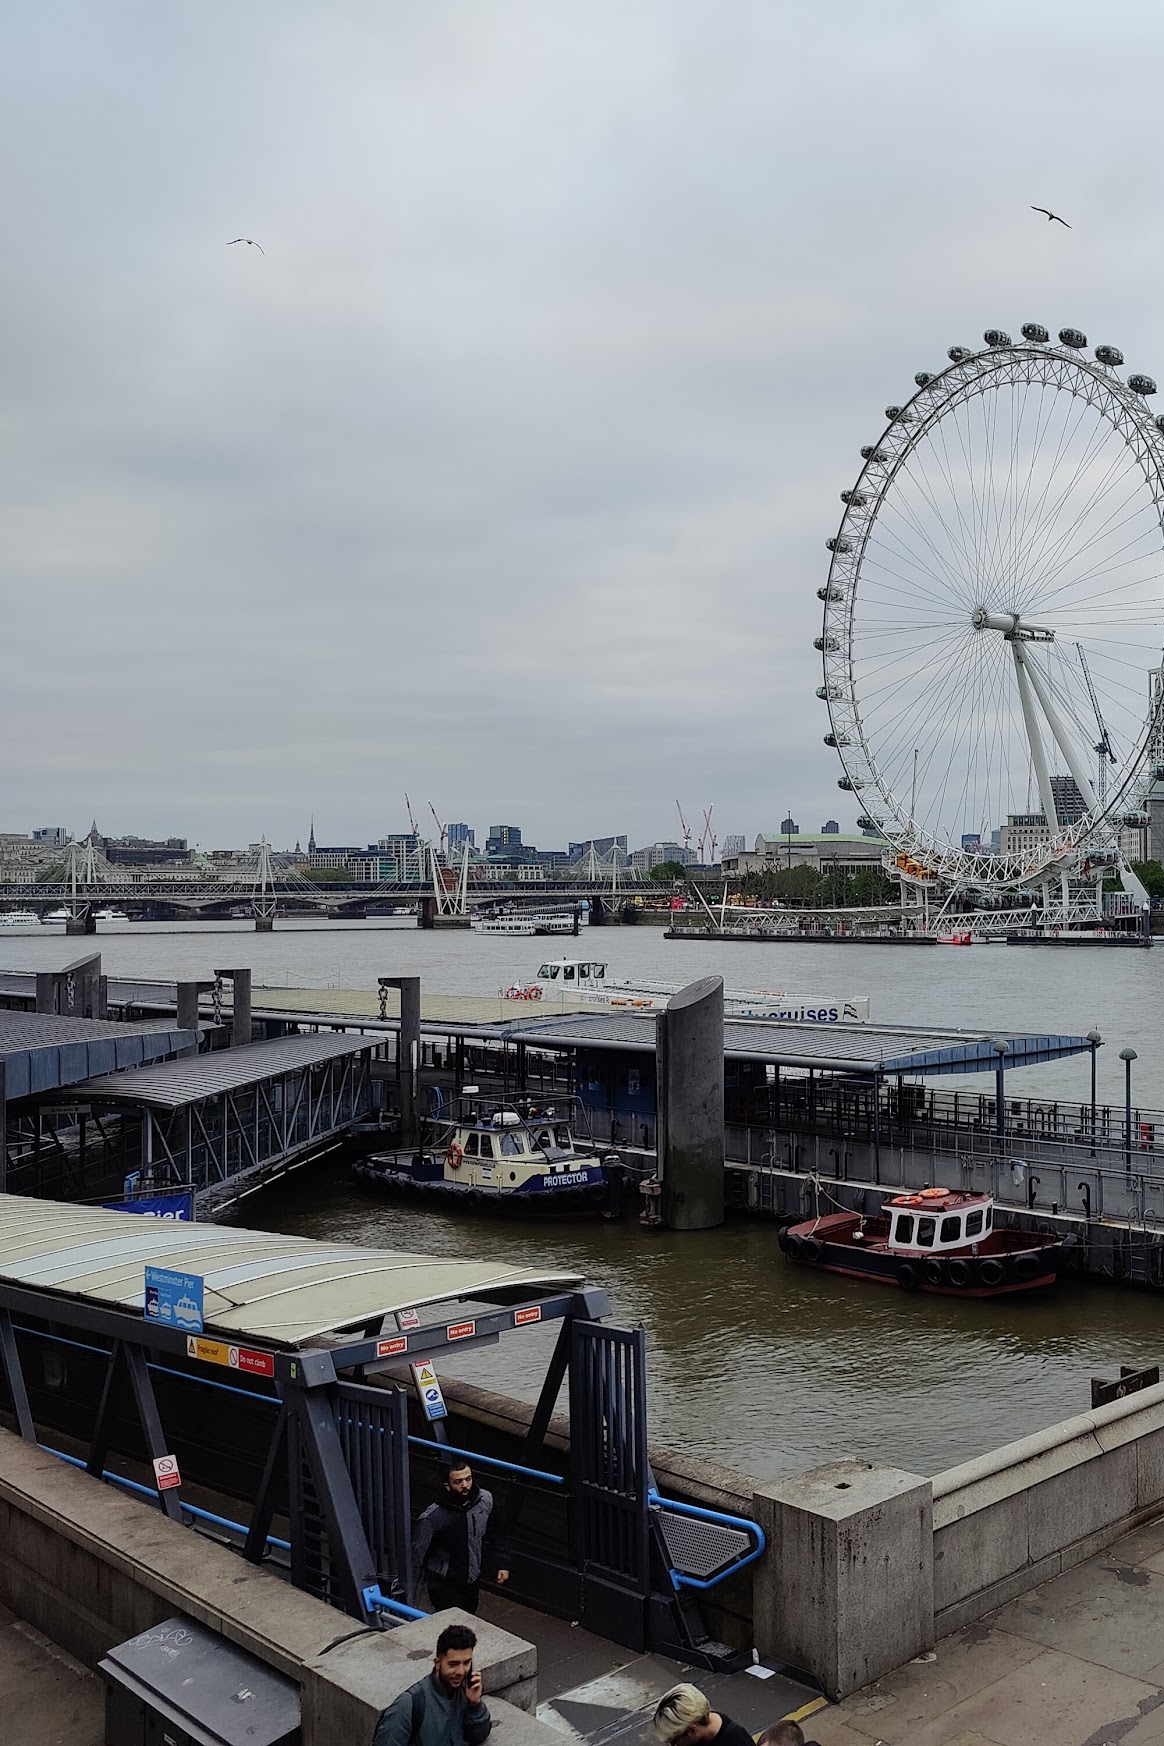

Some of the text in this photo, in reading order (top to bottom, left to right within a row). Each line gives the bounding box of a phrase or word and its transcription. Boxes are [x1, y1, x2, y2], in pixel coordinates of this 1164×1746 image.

[543, 1171, 588, 1187] PROTECTOR
[151, 1270, 195, 1289] Westminster Pier
[526, 1310, 539, 1320] entry
[450, 1325, 472, 1336] No entry
[380, 1341, 405, 1352] No entry
[240, 1354, 246, 1363] Do
[254, 1359, 267, 1369] climb
